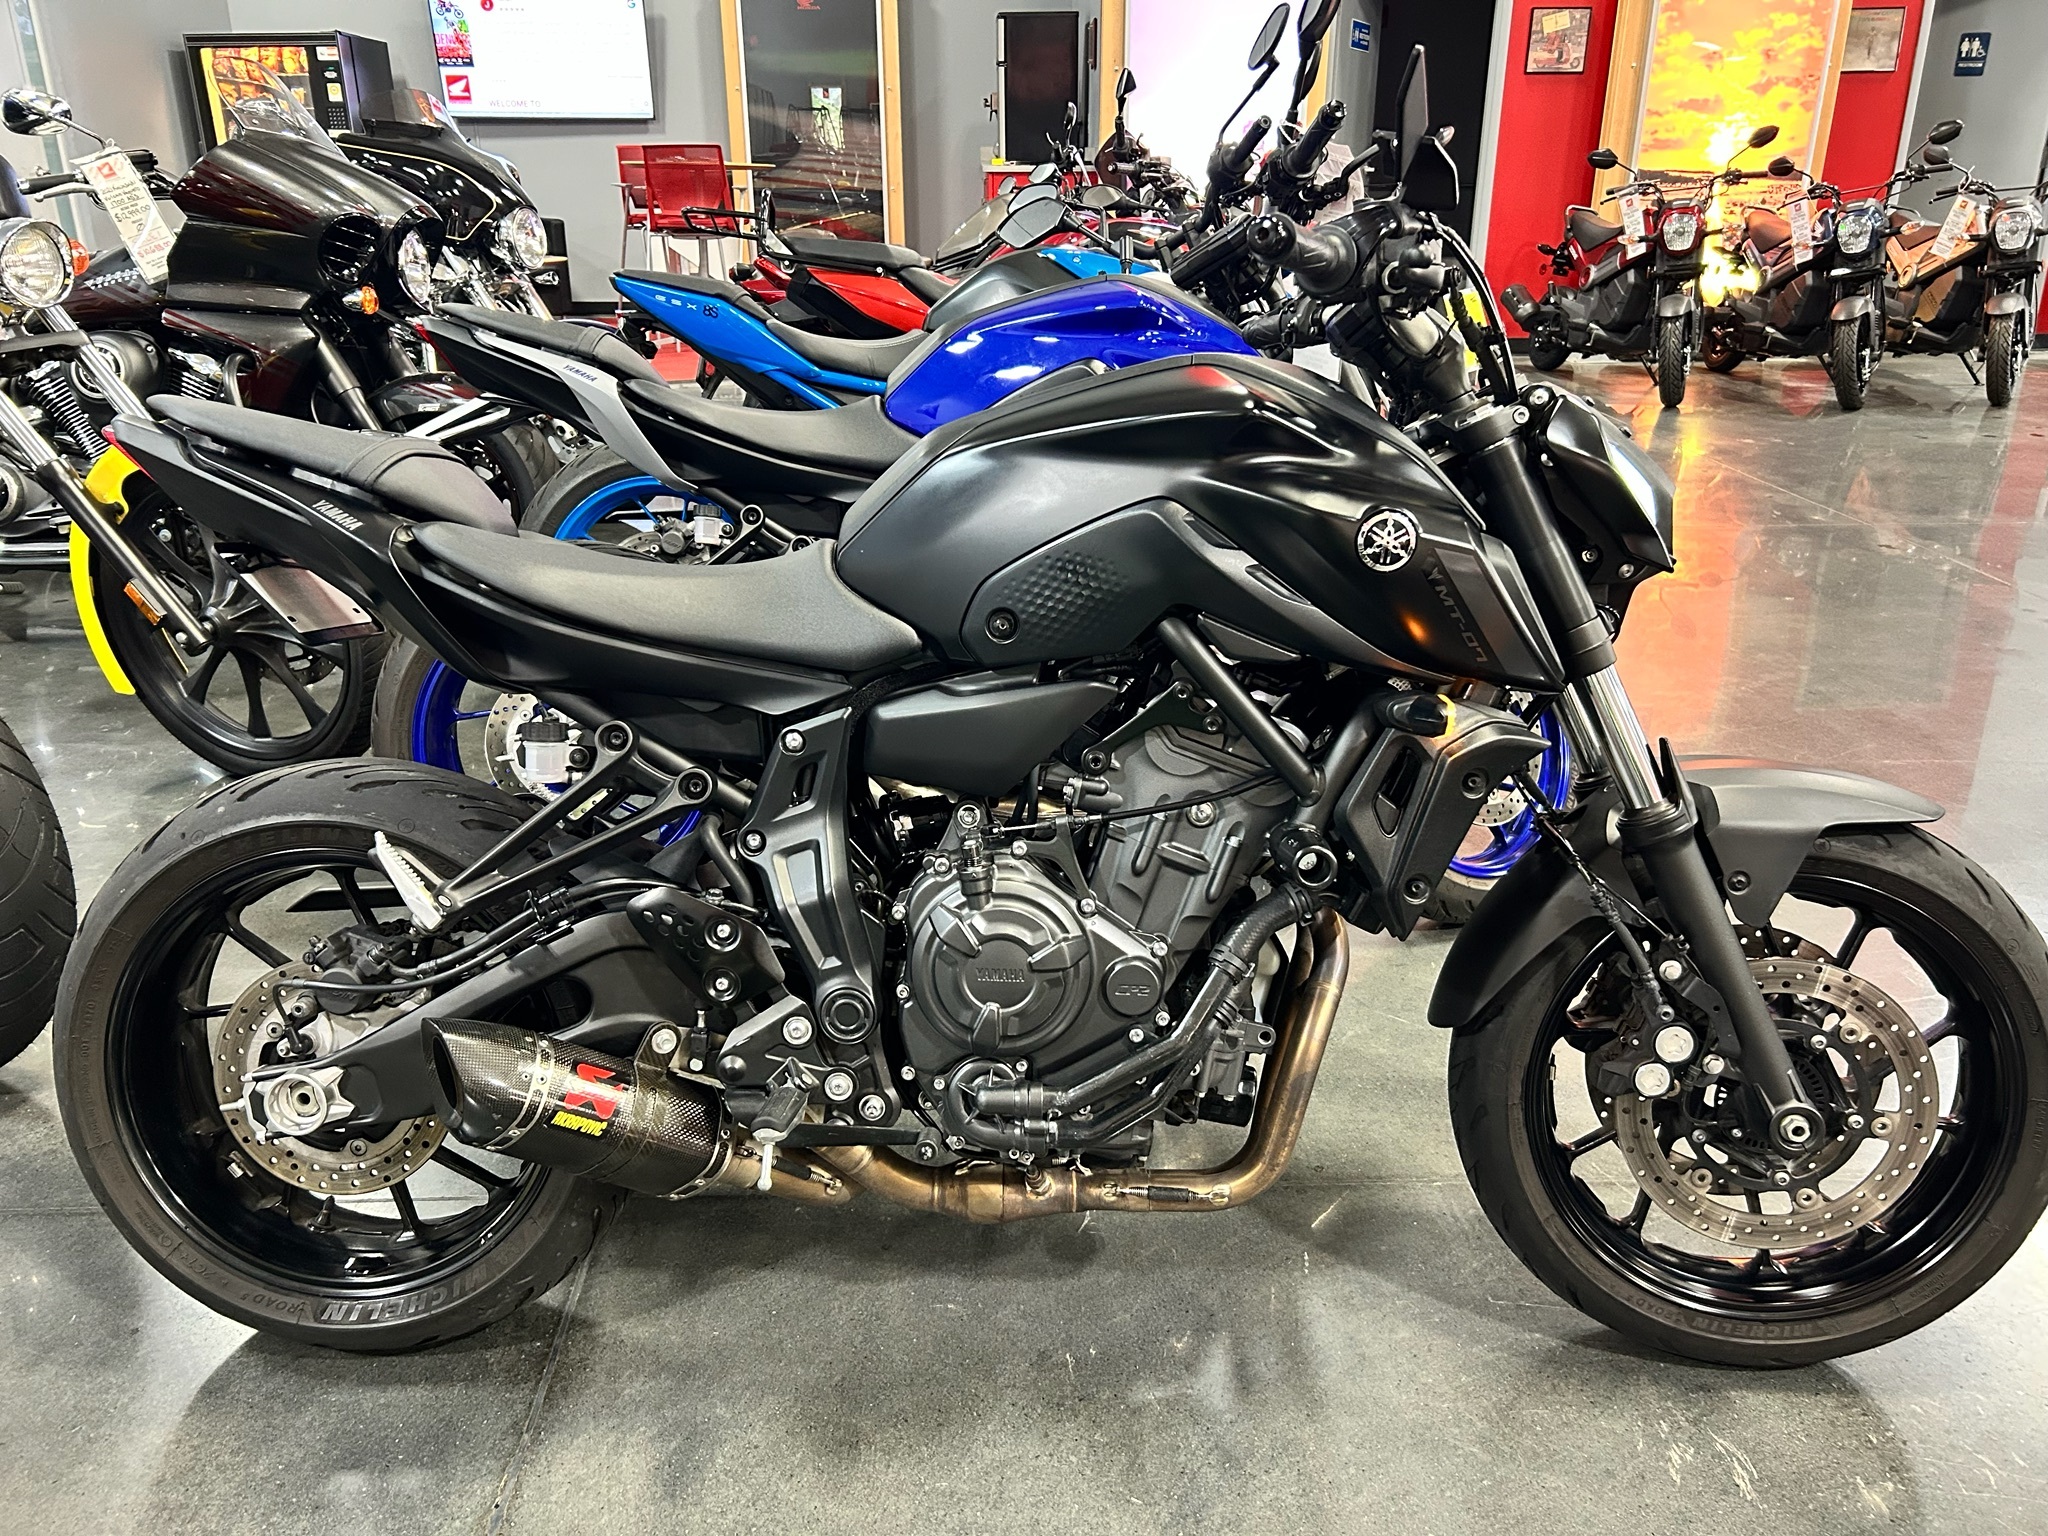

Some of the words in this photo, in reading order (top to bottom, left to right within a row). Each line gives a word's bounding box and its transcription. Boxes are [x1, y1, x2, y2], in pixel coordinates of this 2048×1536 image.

[489, 100, 528, 108] WELCOME
[530, 100, 541, 108] TO
[563, 364, 598, 382] YAMAHA
[312, 499, 364, 531] YAMAHA
[975, 967, 1026, 983] YAMAHA
[252, 1292, 303, 1315] ROAD
[320, 1267, 488, 1323] MICHELIN
[1692, 1317, 1813, 1339] MICHELIN
